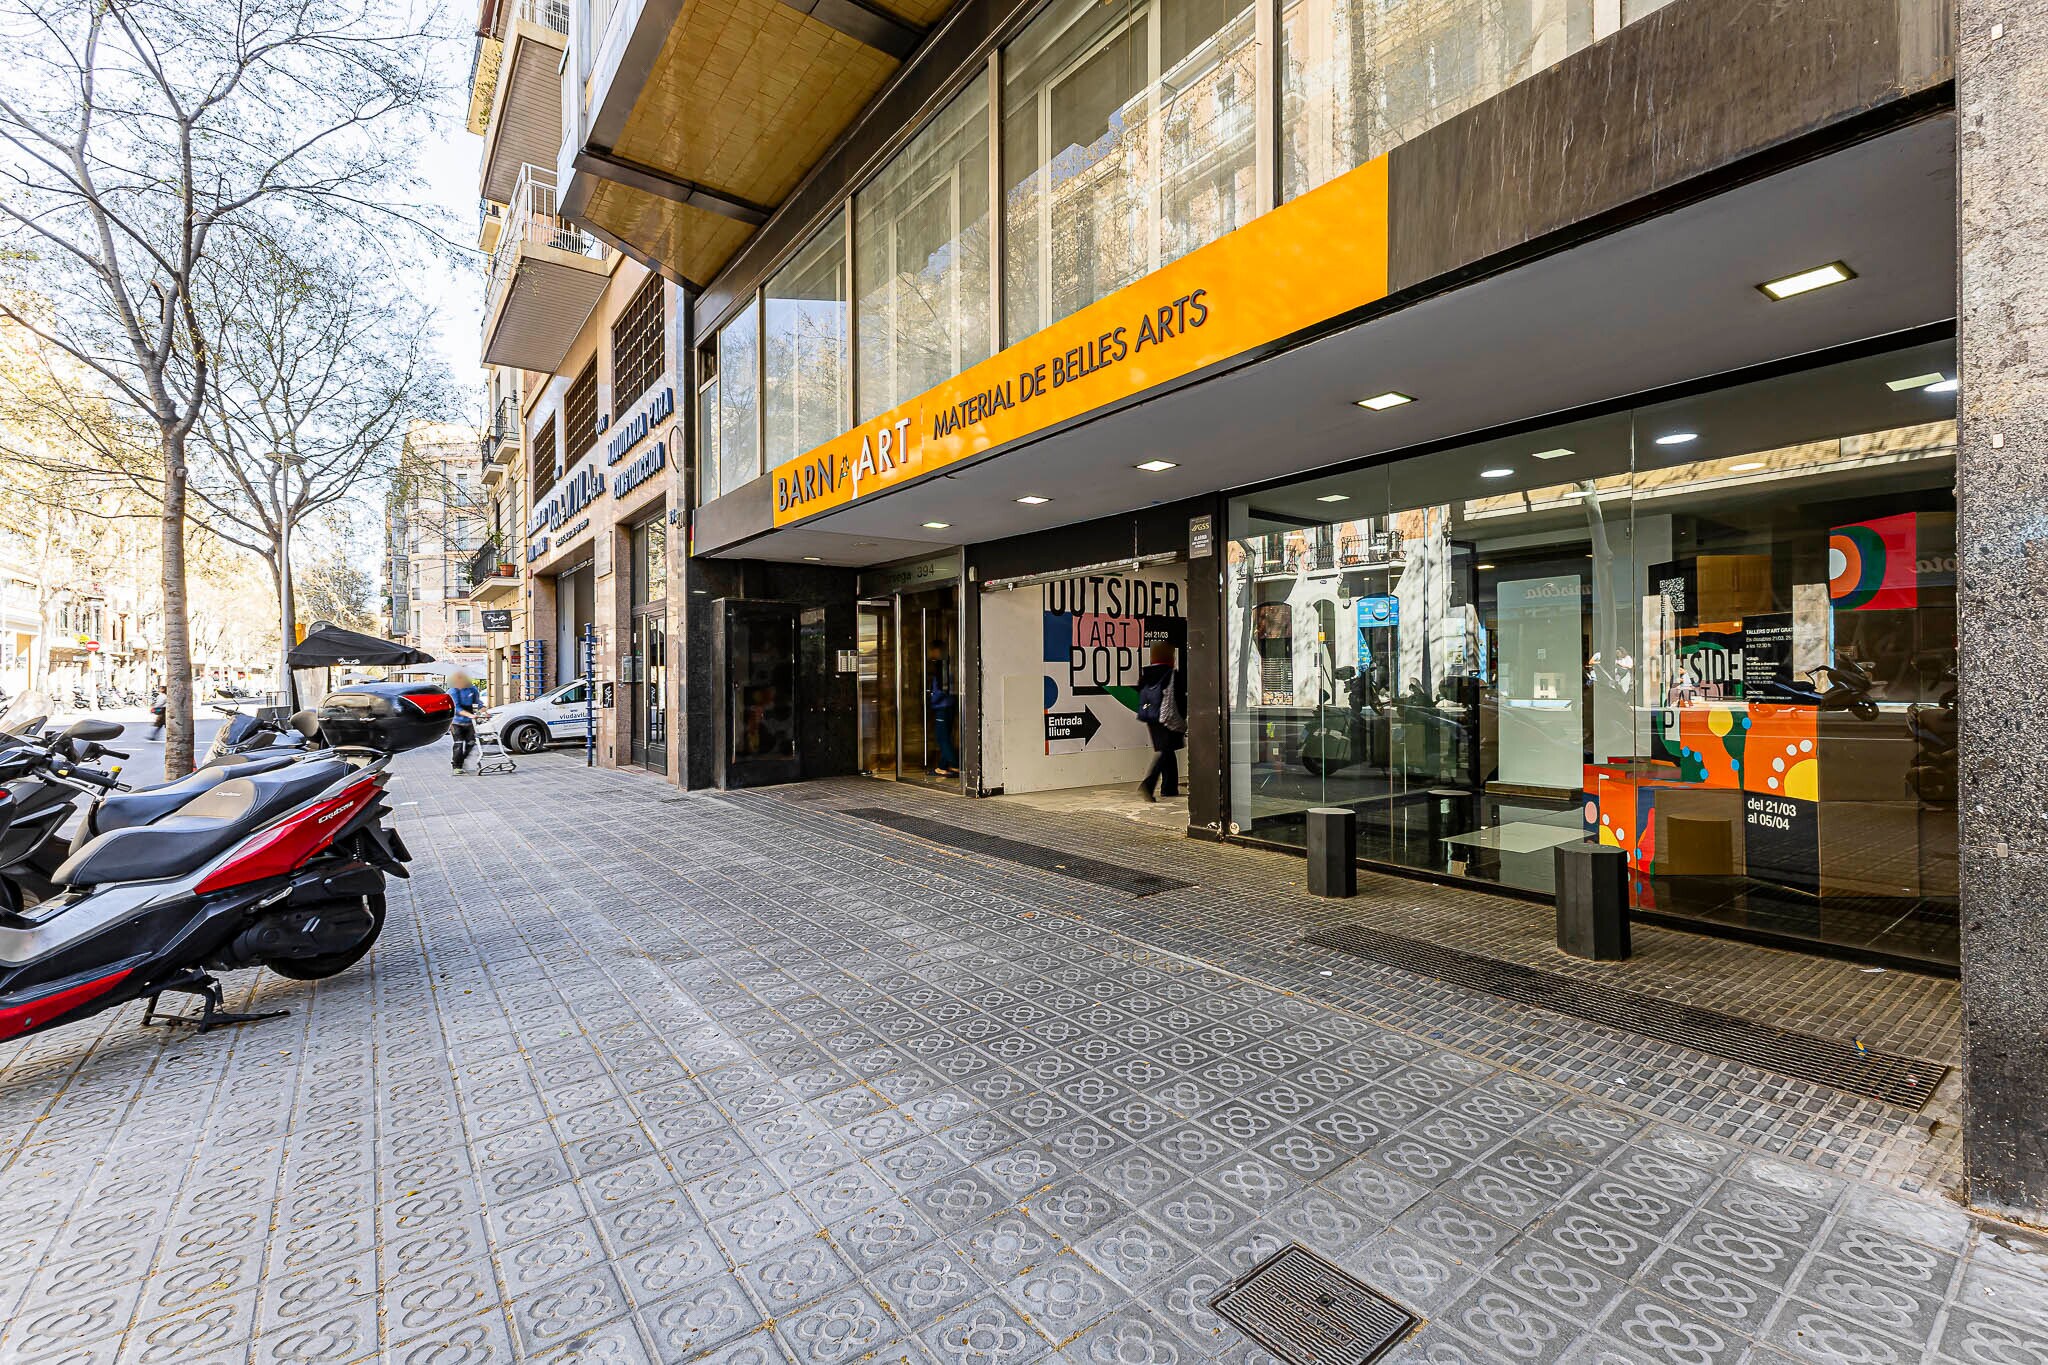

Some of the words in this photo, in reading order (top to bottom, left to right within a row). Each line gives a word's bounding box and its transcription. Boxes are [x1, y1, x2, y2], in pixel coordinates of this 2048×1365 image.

[933, 380, 1015, 440] MATERIAL
[1020, 363, 1046, 402] DE
[1052, 327, 1127, 389] BELLES
[1135, 288, 1208, 352] ARTS
[649, 387, 674, 429] PARA
[1049, 577, 1179, 619] OUTSIDER
[1153, 631, 1168, 639] 21/03
[1049, 716, 1082, 727] Entrada
[1049, 727, 1070, 737] lliure
[1747, 798, 1764, 811] del
[1765, 800, 1797, 817] 21/03
[1747, 812, 1758, 824] al
[1759, 814, 1790, 831] 05/04
[1268, 1287, 1312, 1319] POTABLE
[1315, 1318, 1350, 1343] AIGUA
